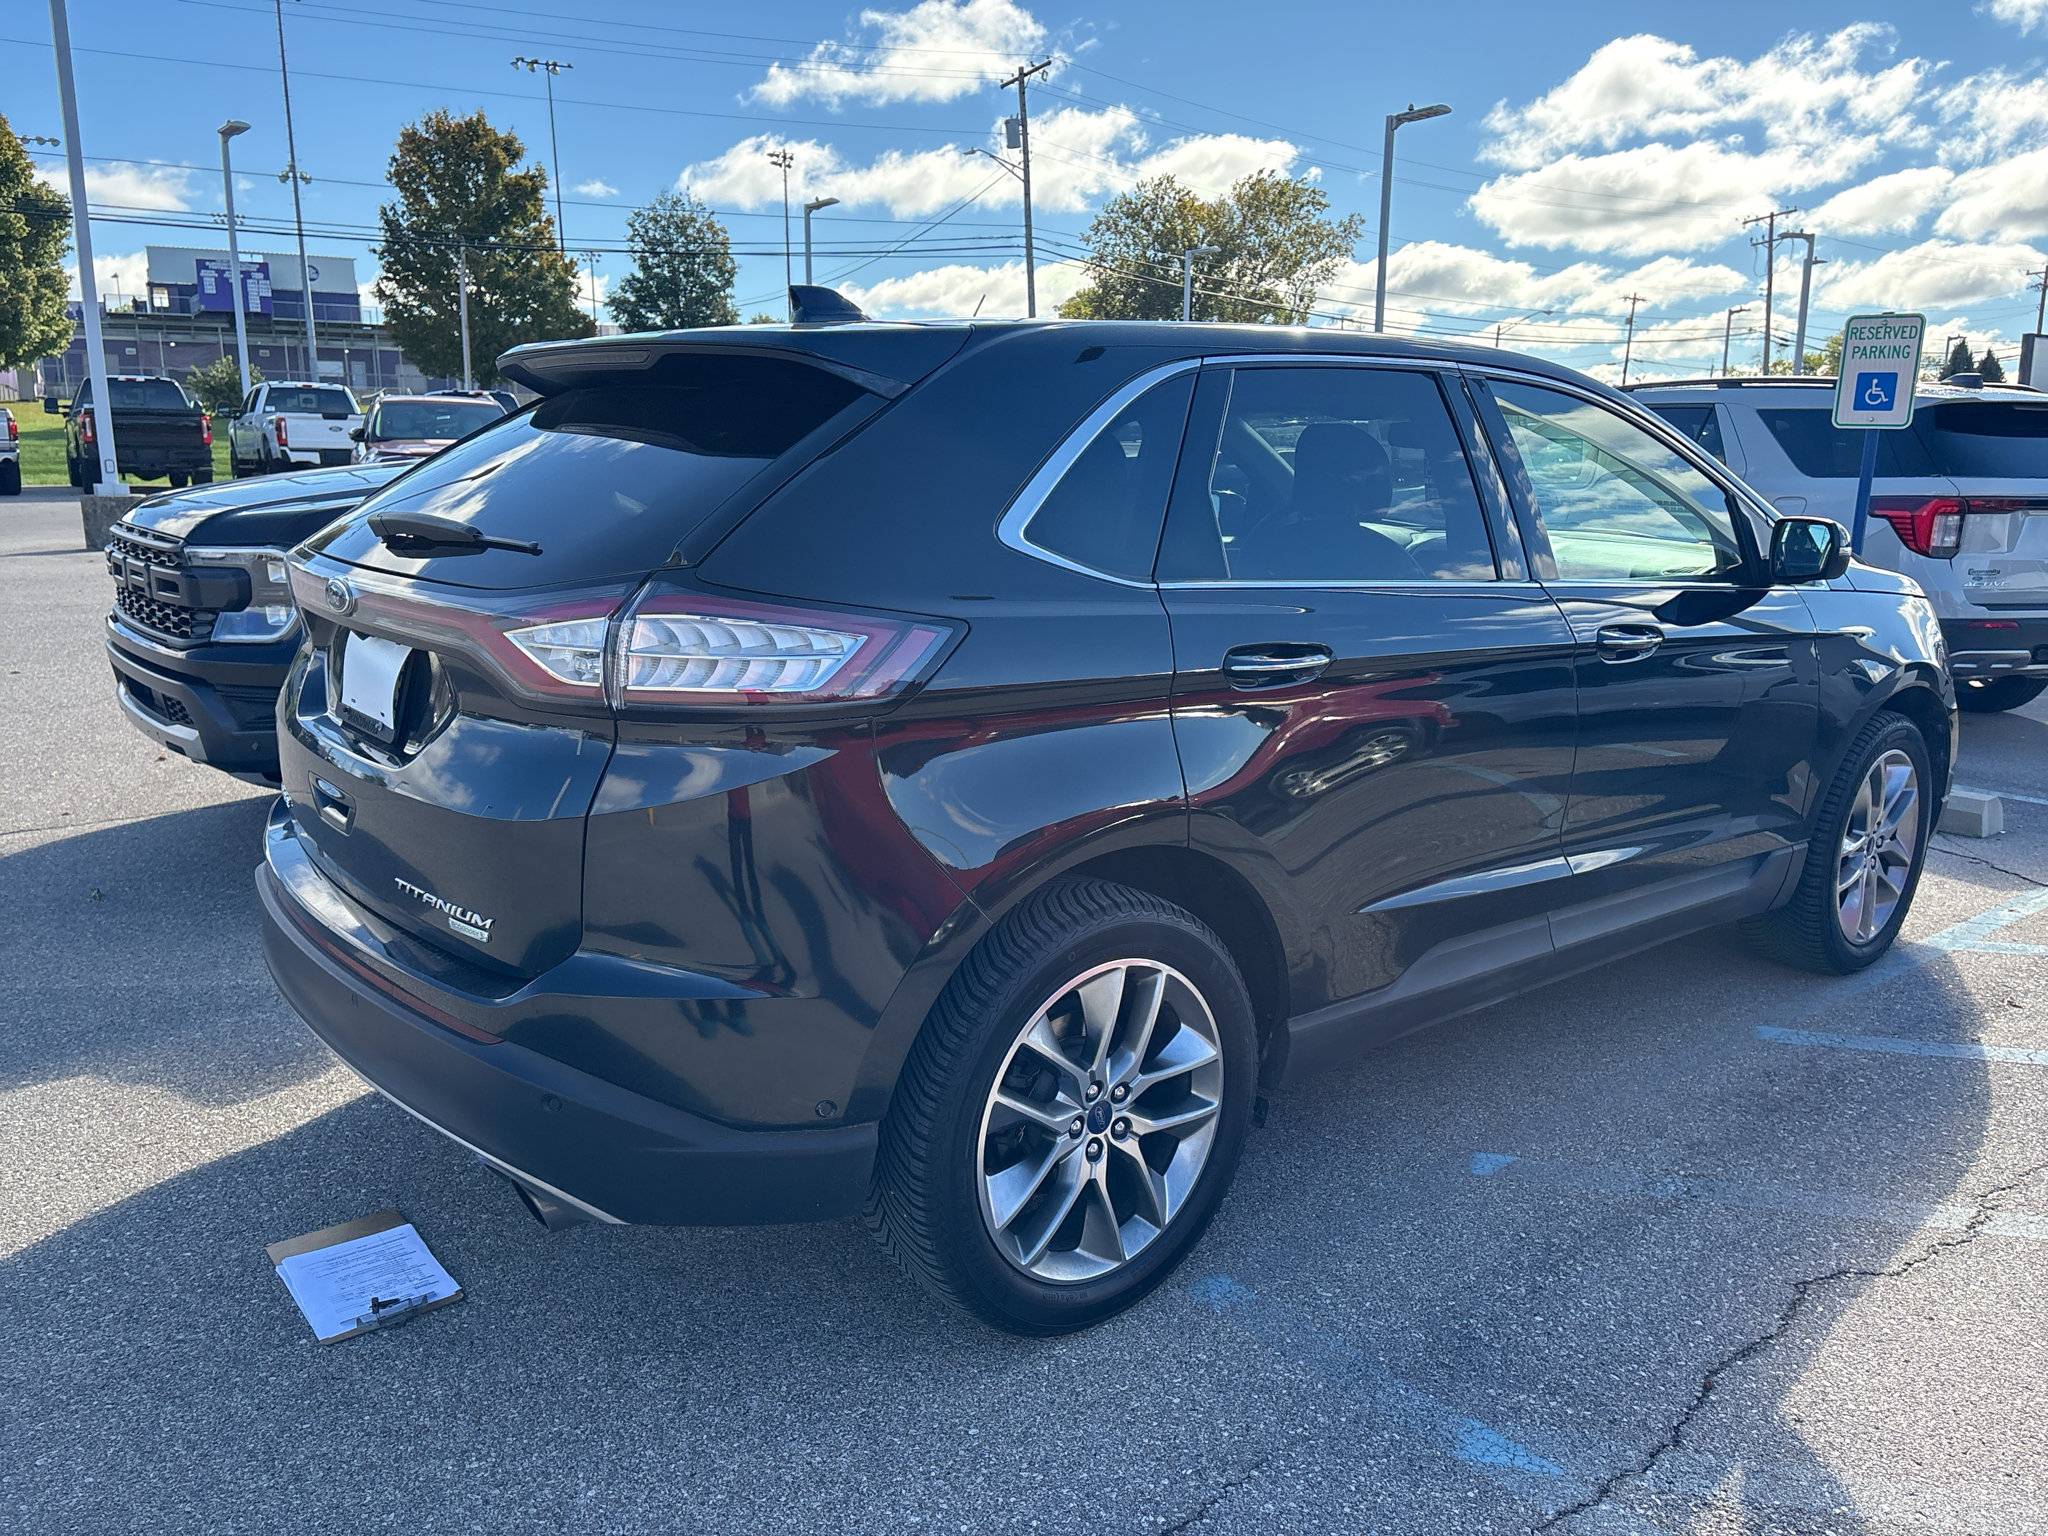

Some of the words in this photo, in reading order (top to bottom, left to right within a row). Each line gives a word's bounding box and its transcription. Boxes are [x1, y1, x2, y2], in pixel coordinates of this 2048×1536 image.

[1850, 326, 1918, 340] RESERVED
[1851, 345, 1911, 360] PARKING
[394, 877, 495, 930] TITANIUM
